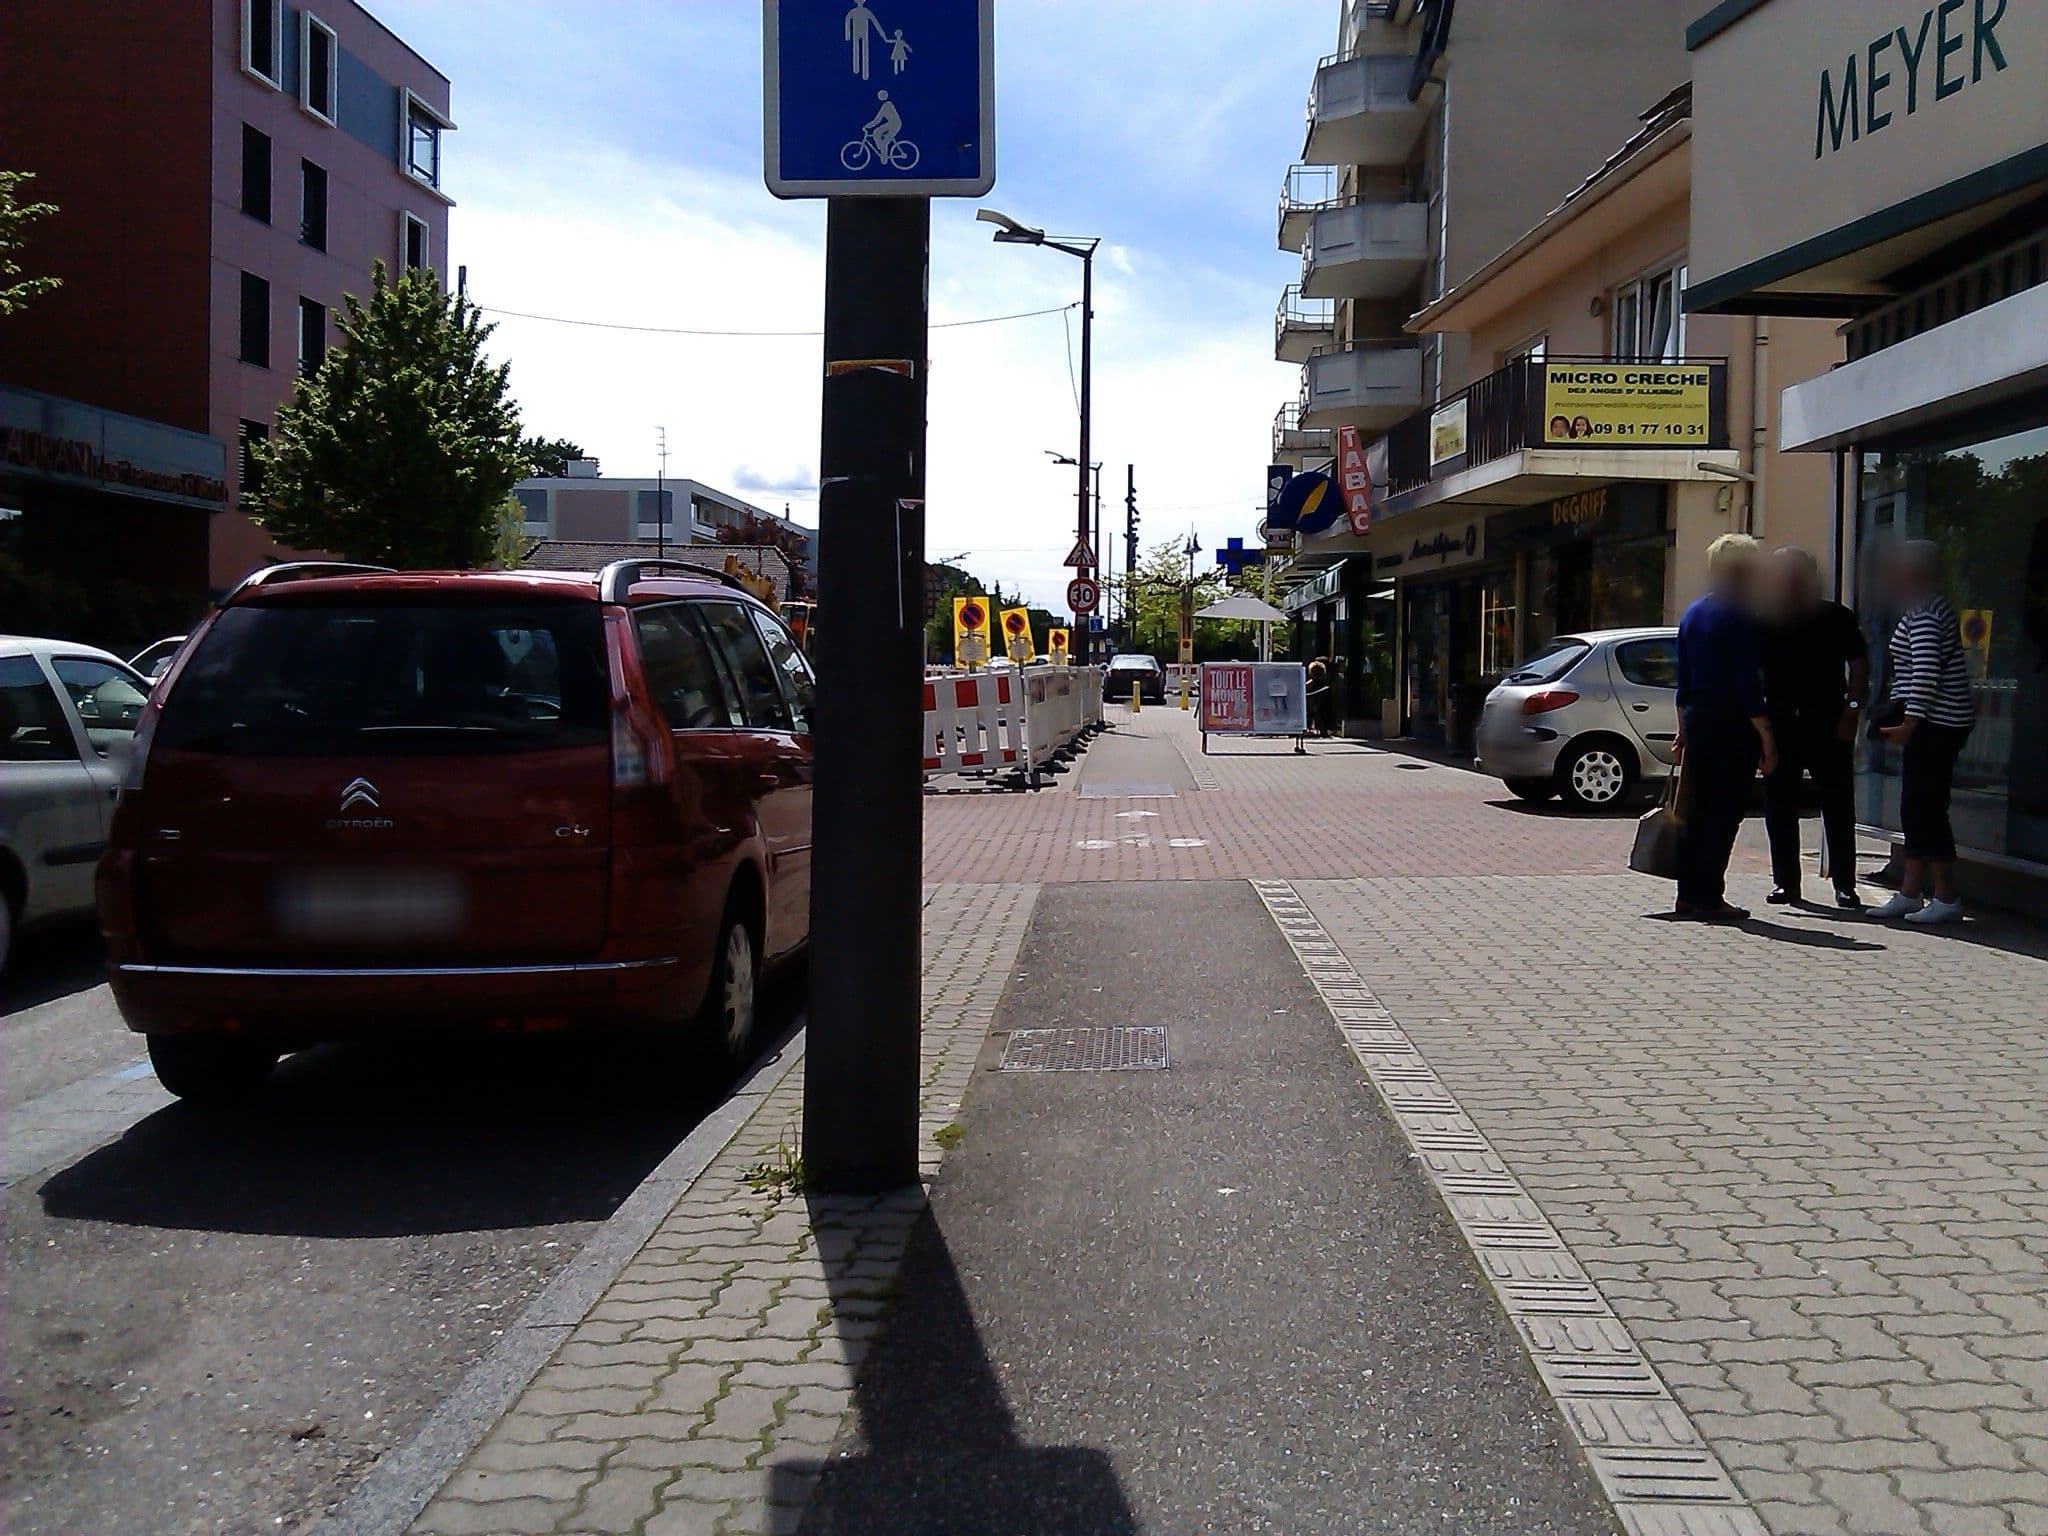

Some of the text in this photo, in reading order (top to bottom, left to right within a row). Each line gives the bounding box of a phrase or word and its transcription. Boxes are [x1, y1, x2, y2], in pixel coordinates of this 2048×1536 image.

[1816, 0, 2007, 160] MEYER
[1550, 372, 1708, 386] MICRO CRECHE
[1594, 424, 1704, 435] 09 81 77 10 31
[1342, 431, 1369, 530] TABAC
[1072, 588, 1091, 602] 30
[1210, 670, 1247, 689] TOUT LE
[1210, 689, 1247, 702] MONDE
[1211, 702, 1229, 717] LIT
[555, 823, 590, 838] C4
